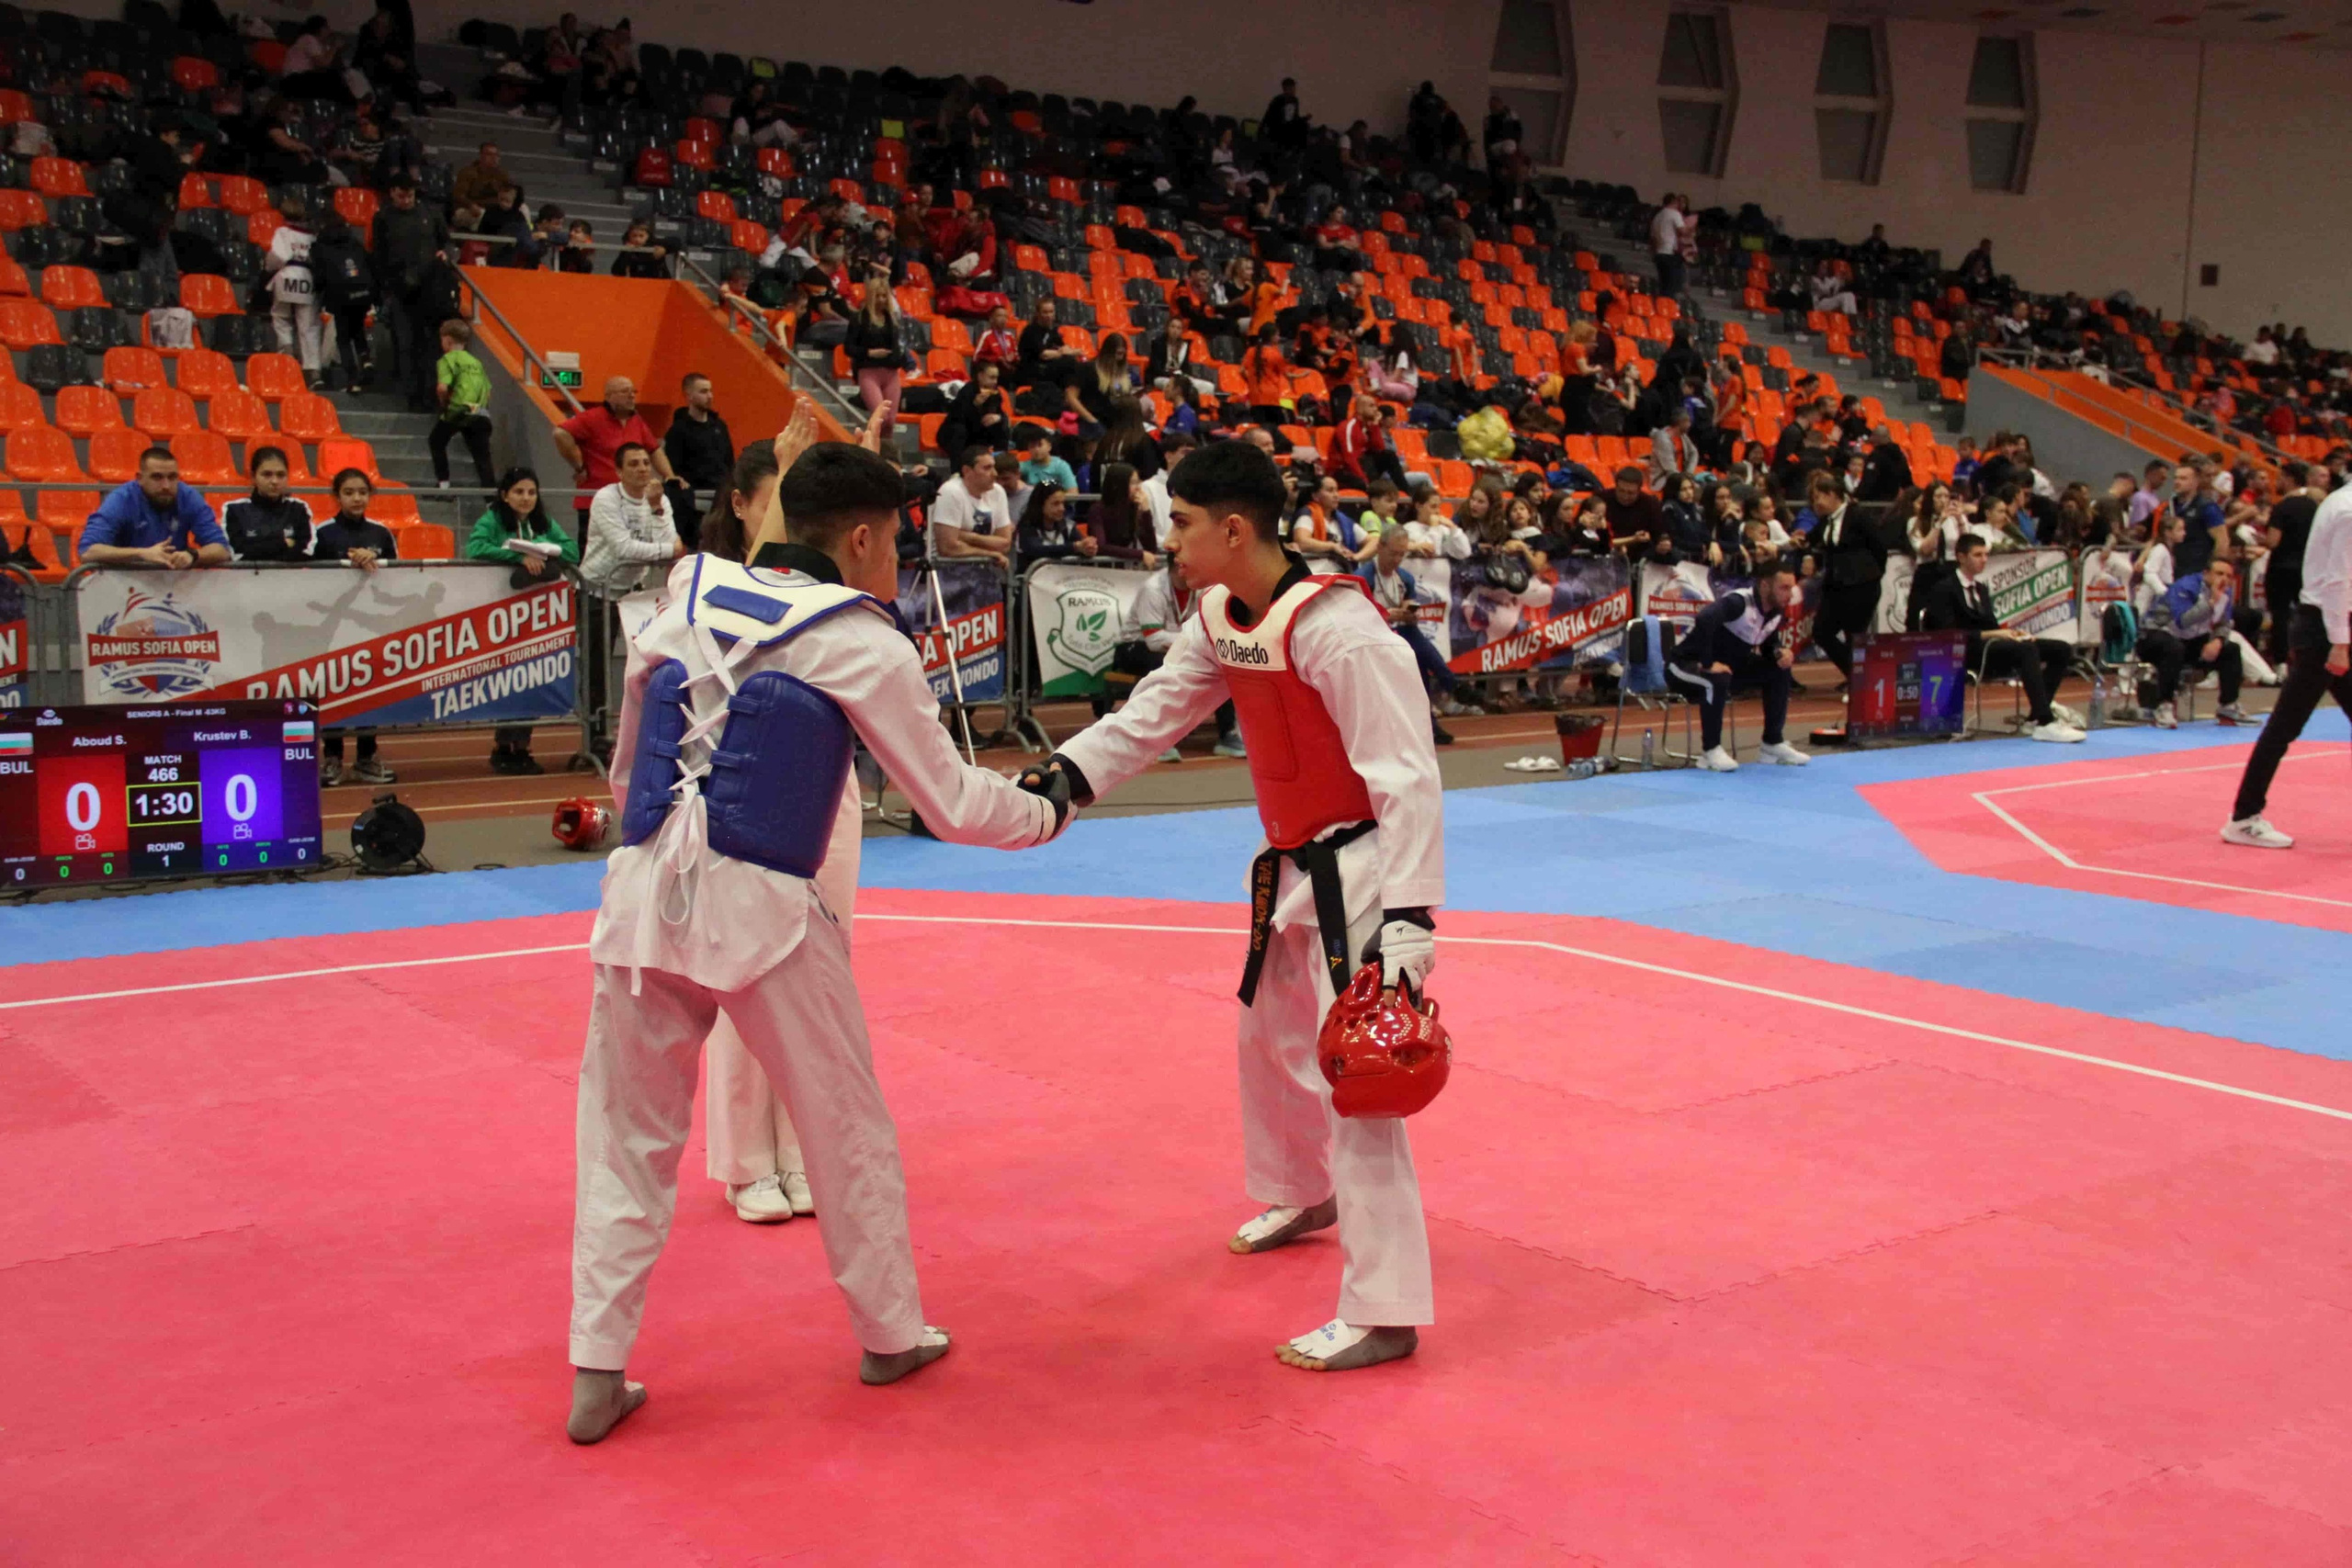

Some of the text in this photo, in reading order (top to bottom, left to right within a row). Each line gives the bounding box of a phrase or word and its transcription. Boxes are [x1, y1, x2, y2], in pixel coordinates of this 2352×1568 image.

[284, 278, 311, 294] MD
[1992, 557, 2036, 591] SPONSOR
[1994, 582, 2032, 618] SOFIA
[2034, 564, 2068, 598] OPEN
[1068, 597, 1112, 607] RAMUS
[382, 617, 480, 677] SOFIA
[487, 588, 571, 644] OPEN
[1482, 629, 1542, 672] RAMUS
[1544, 611, 1587, 649] SOFIA
[1589, 592, 1627, 628] OPEN
[92, 640, 216, 656] RAMUS SOFIA OPEN
[1229, 639, 1269, 664] Daedo
[422, 633, 571, 692] INTERNATIONAL TOURNAMENT
[431, 650, 571, 719] TAEKWONDO
[1930, 675, 1942, 705] 7
[1874, 679, 1884, 707] 1
[127, 710, 162, 718] SENIORS
[73, 735, 127, 747] Aboud S.
[194, 730, 252, 741] Krustev B.
[144, 755, 182, 764] MATCH
[285, 748, 314, 761] BUL
[0, 761, 34, 774] BUL
[148, 768, 178, 781] 466
[135, 792, 193, 816] 1:30
[225, 774, 257, 821] 0
[66, 783, 101, 831] 0
[147, 842, 185, 852] ROUND
[219, 854, 228, 866] 0
[259, 852, 268, 863] 0
[298, 848, 306, 860] 0
[162, 855, 170, 867] 1
[15, 868, 25, 880] 0
[60, 865, 69, 877] 0
[103, 863, 113, 874] 0
